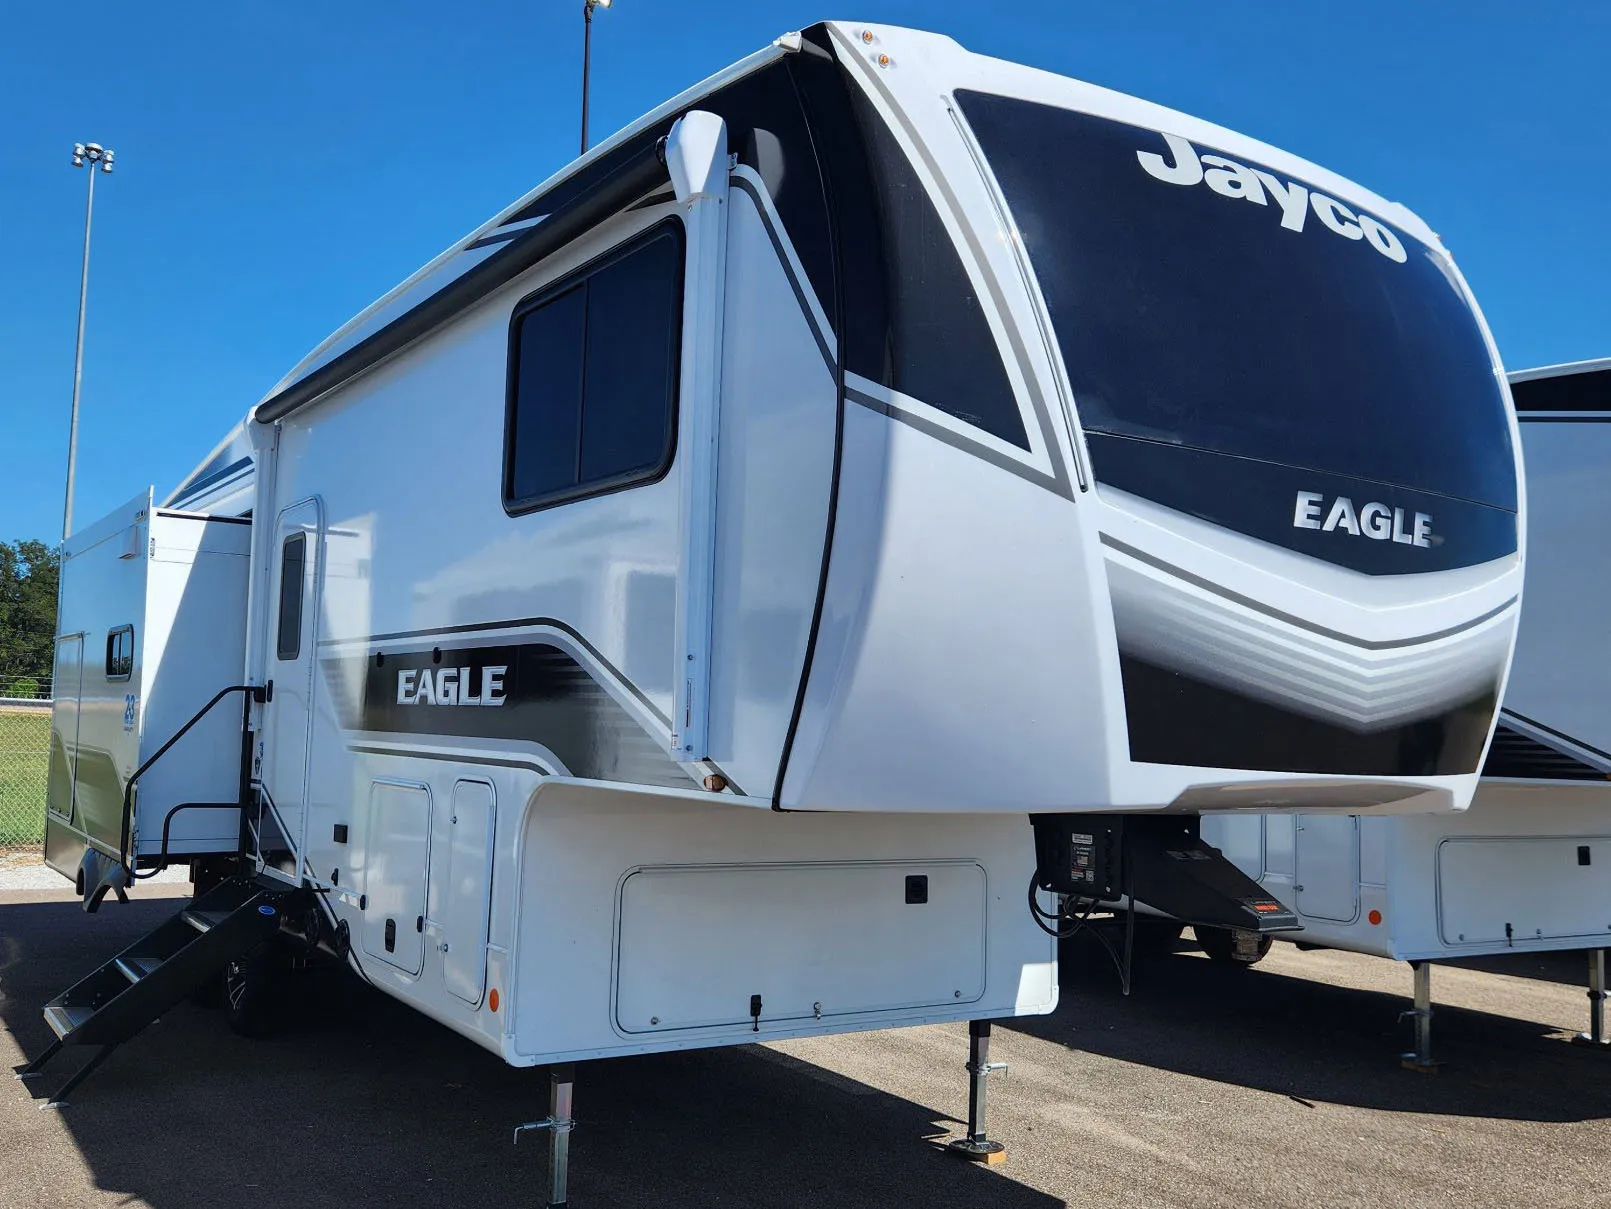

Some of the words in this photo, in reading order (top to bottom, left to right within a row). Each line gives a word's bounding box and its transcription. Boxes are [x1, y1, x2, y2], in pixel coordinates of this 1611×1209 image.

[1136, 132, 1407, 263] Jayco
[1293, 490, 1433, 548] EAGLE
[397, 666, 508, 706] EAGLE
